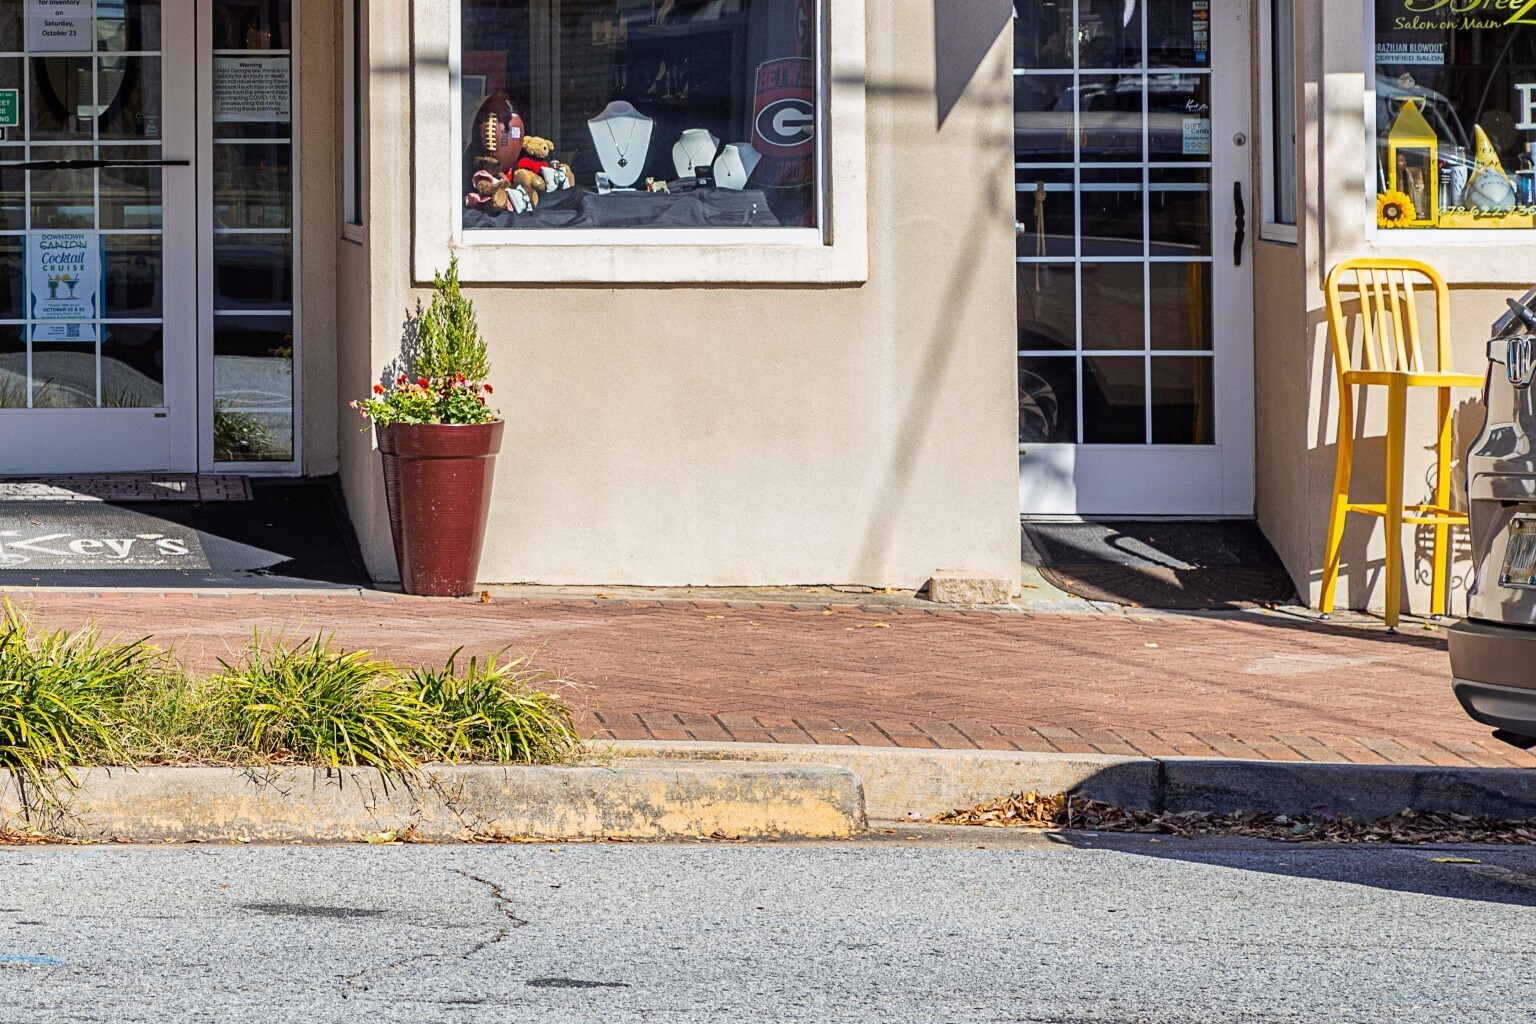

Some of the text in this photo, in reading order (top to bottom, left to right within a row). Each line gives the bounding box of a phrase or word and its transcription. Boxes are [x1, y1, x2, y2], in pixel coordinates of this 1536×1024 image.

[44, 20, 75, 28] Saturday,
[1393, 15, 1502, 31] Salon on Main
[1410, 43, 1443, 53] BLOWOUT
[40, 240, 87, 249] CANTON
[41, 252, 85, 264] Cocktail
